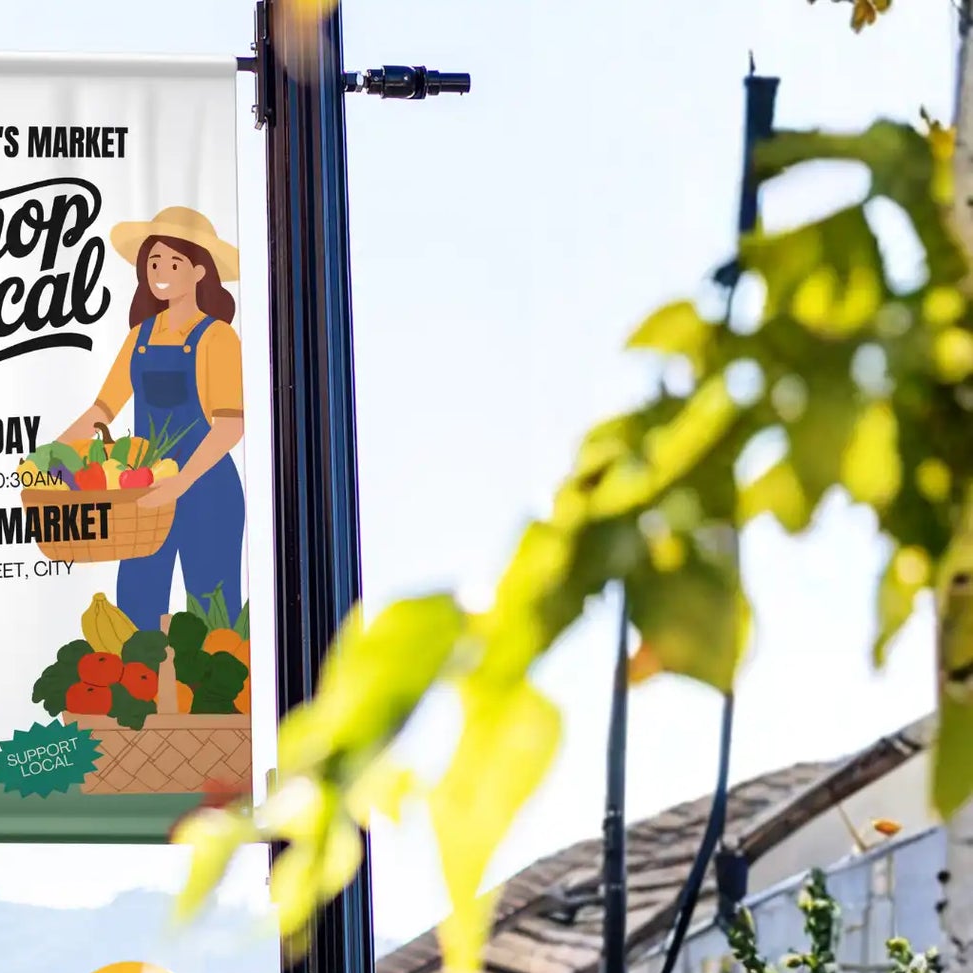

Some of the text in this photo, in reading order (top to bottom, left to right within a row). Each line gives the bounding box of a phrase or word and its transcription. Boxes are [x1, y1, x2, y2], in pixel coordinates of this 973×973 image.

[28, 126, 128, 158] MARKET
[33, 559, 75, 577] CITY
[7, 737, 78, 767] SUPPORT
[20, 754, 74, 777] LOCAL
